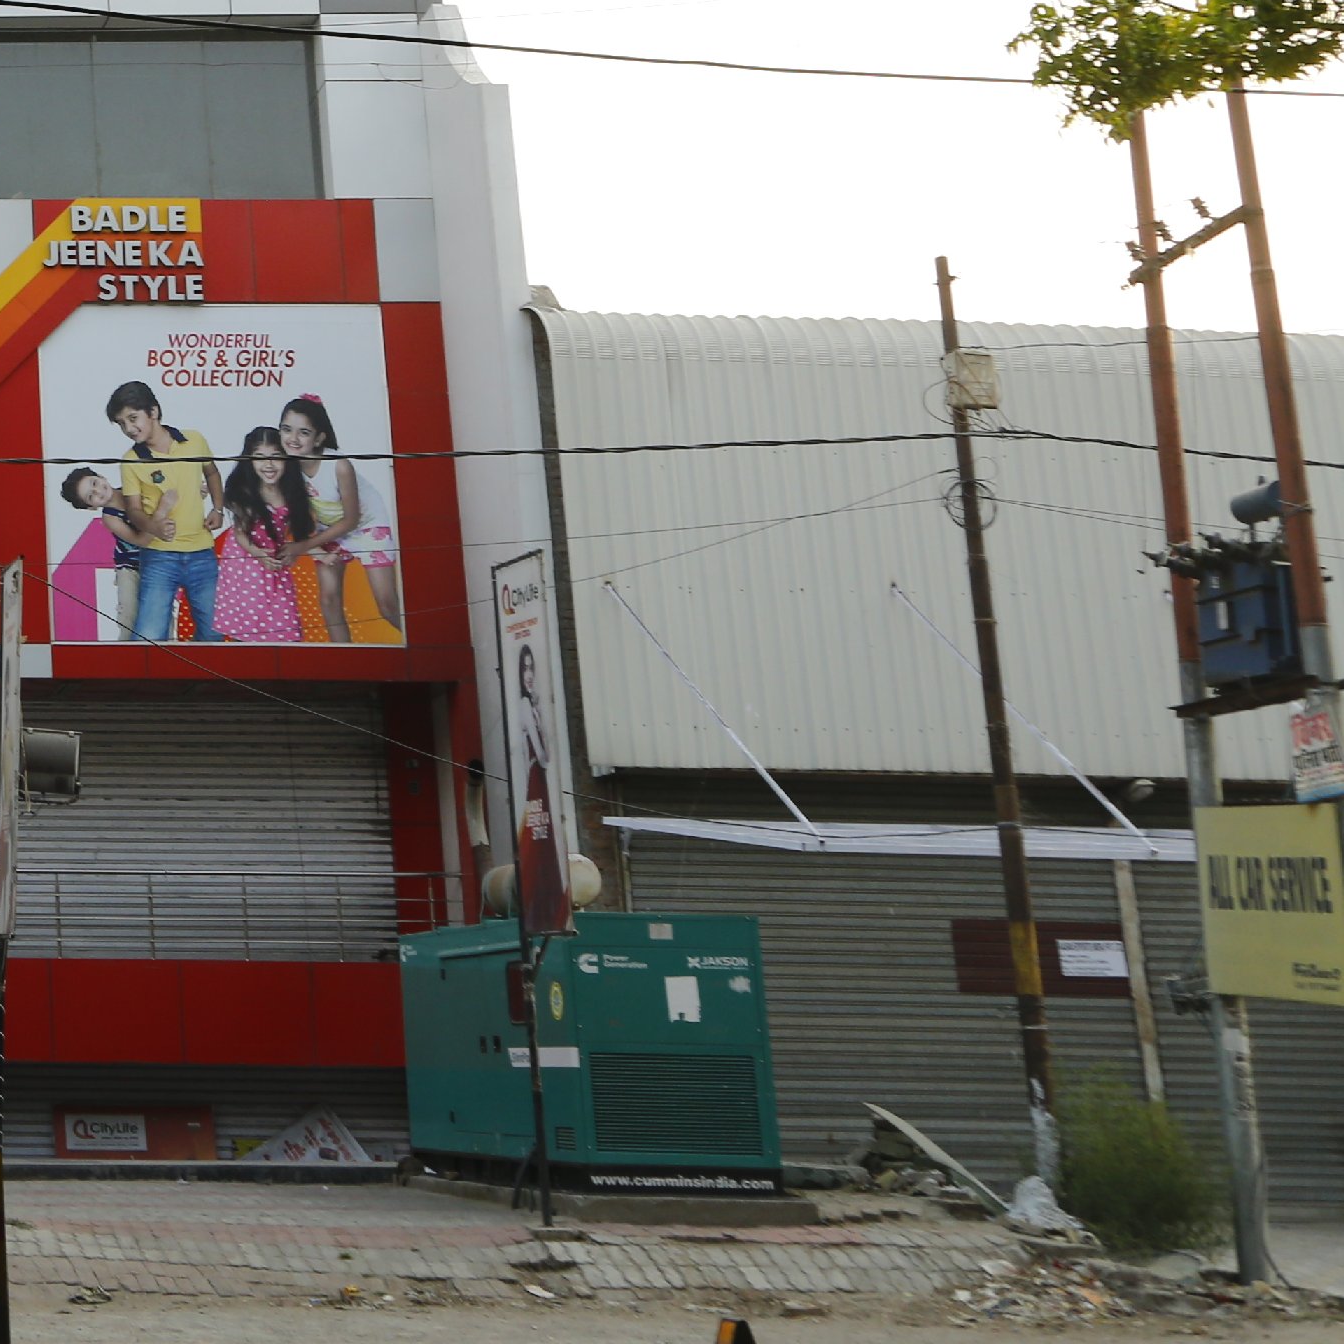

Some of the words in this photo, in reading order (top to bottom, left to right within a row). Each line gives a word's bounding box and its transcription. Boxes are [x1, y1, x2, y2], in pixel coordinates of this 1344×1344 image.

[70, 205, 188, 233] BADLE
[42, 240, 143, 268] JEENE
[147, 240, 205, 268] KA
[97, 273, 205, 302] STYLE
[168, 333, 273, 348] WONDERFUL
[214, 349, 229, 368] &
[161, 369, 284, 388] COLLECTION
[1236, 855, 1268, 912] CAR
[1268, 856, 1334, 914] SERVICE
[590, 1174, 775, 1190] www.cumminsindia.com
